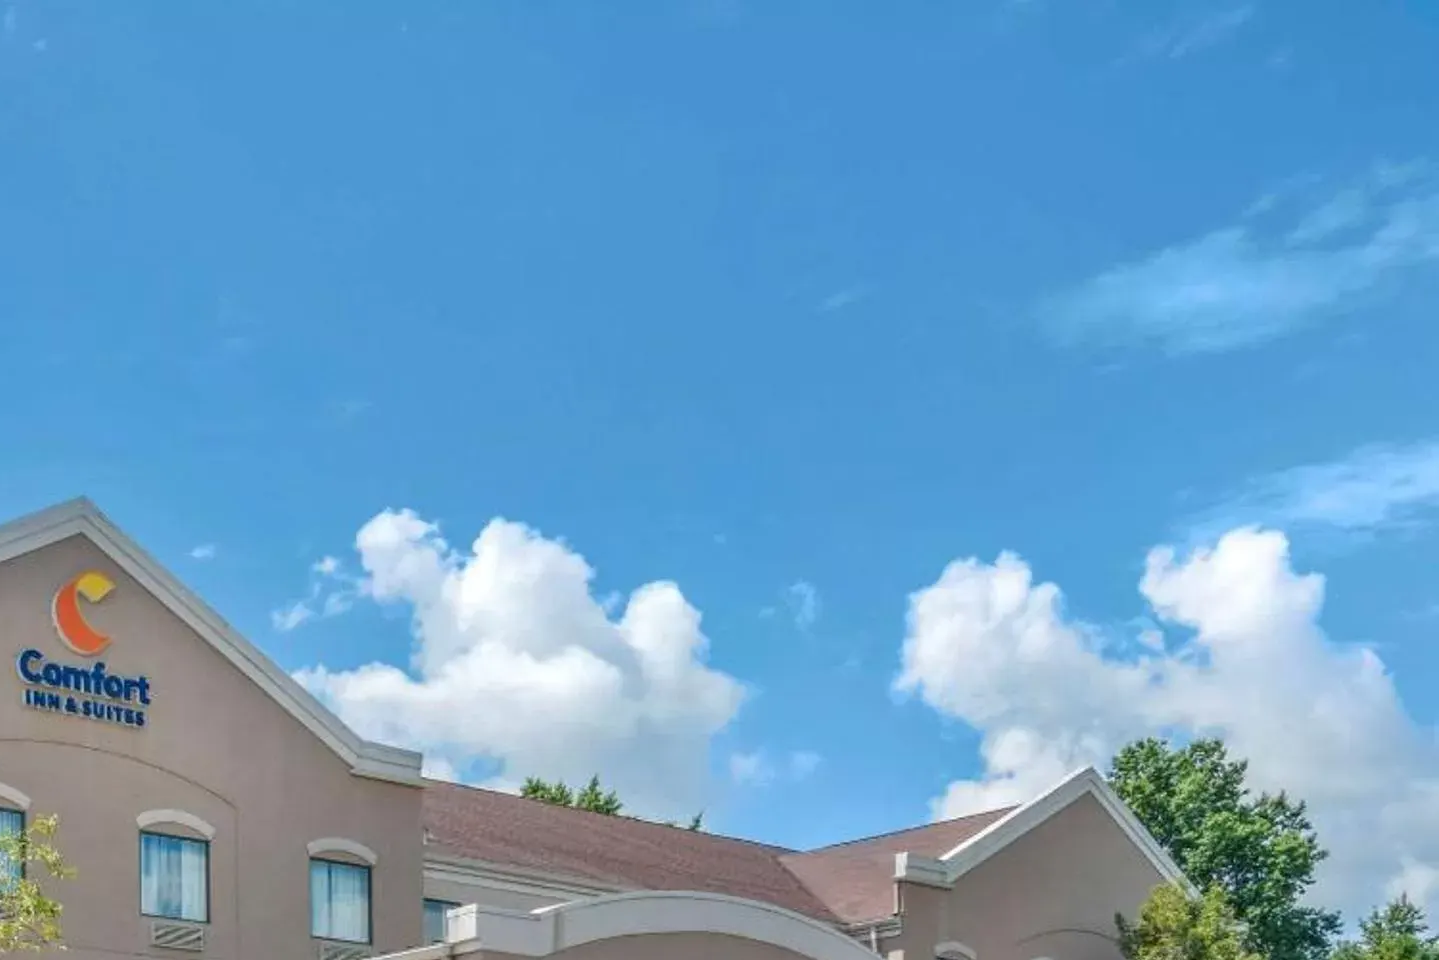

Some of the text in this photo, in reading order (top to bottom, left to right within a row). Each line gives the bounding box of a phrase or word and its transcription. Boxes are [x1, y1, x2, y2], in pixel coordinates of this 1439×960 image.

[16, 648, 152, 706] Comfort
[23, 688, 148, 728] INN & SUITES
